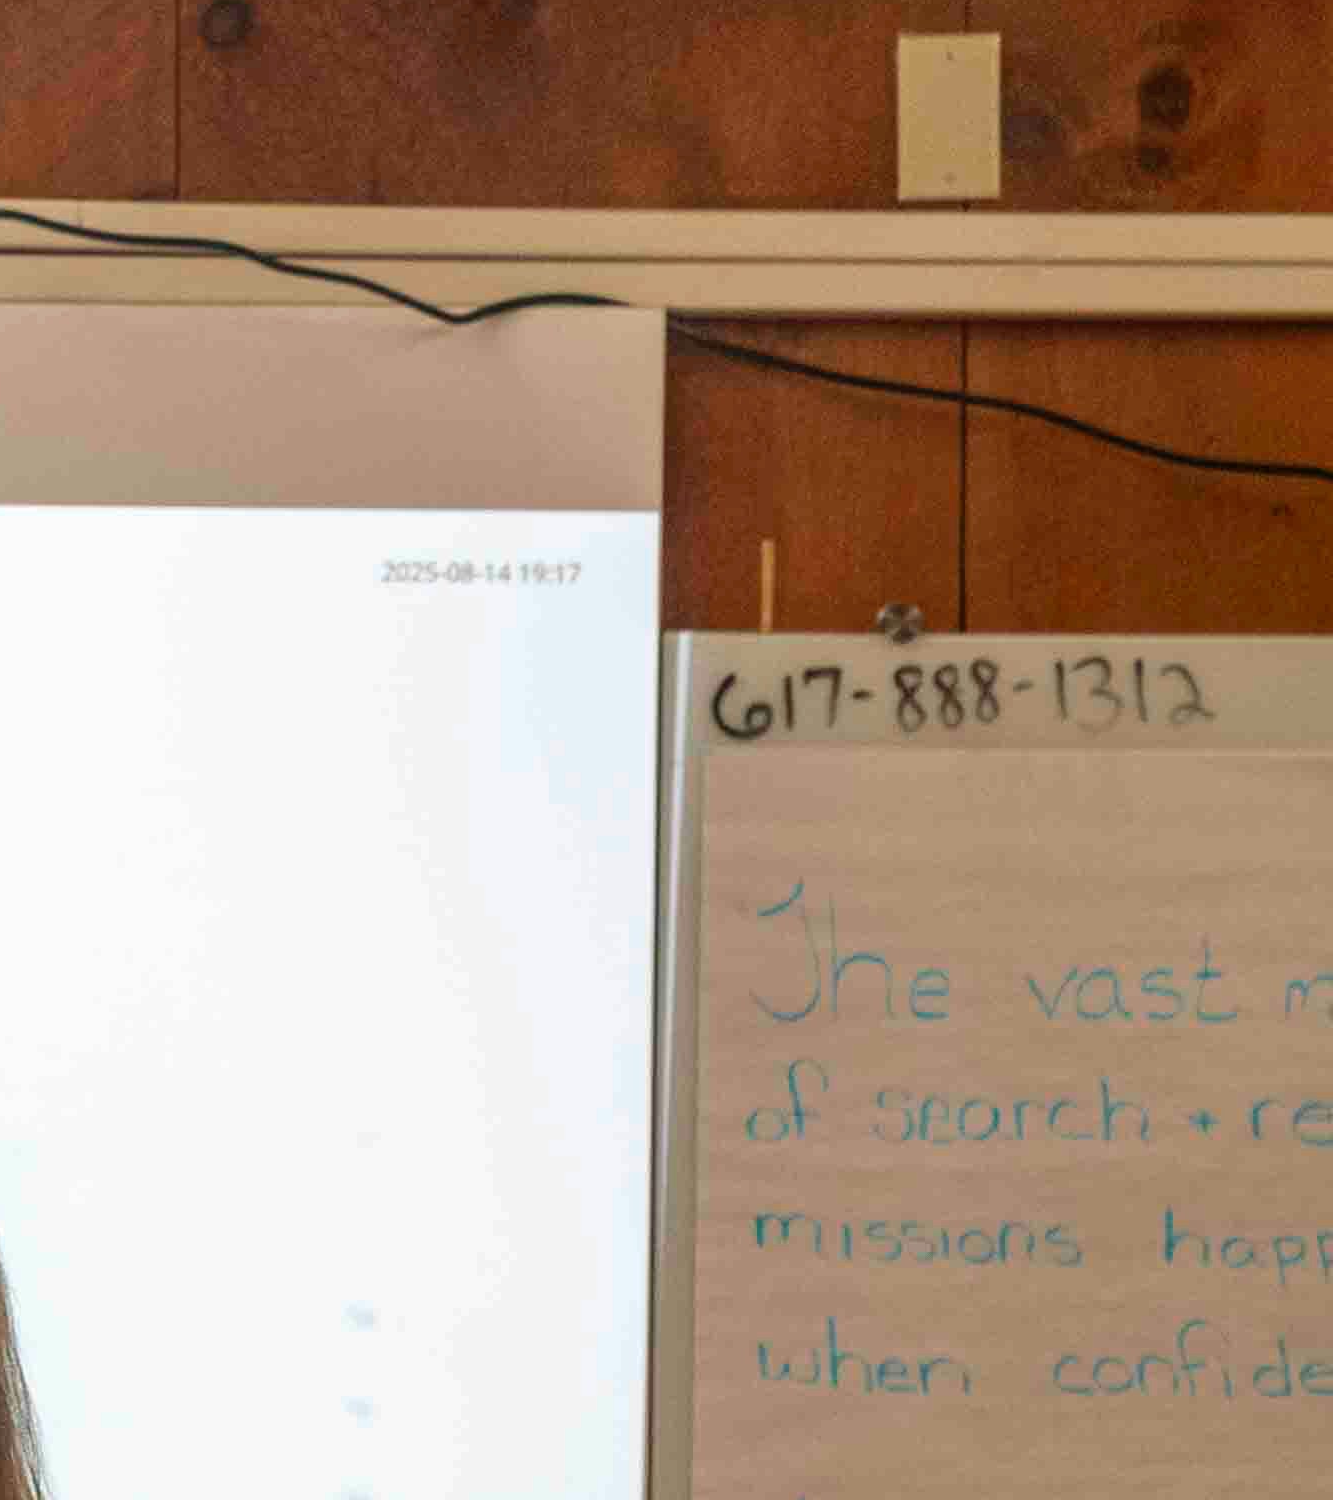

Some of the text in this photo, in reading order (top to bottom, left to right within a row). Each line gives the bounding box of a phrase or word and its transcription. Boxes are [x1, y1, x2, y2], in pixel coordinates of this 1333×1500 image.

[380, 558, 512, 584] 2025-08-14
[711, 656, 1217, 740] 617-888-1312
[748, 877, 952, 1023] The
[1025, 932, 1239, 1022] vast
[744, 1058, 829, 1142] of
[874, 1076, 1151, 1145] search
[1247, 1097, 1333, 1150] re
[751, 1209, 1084, 1268] missions
[757, 1314, 1333, 1398] when confide
